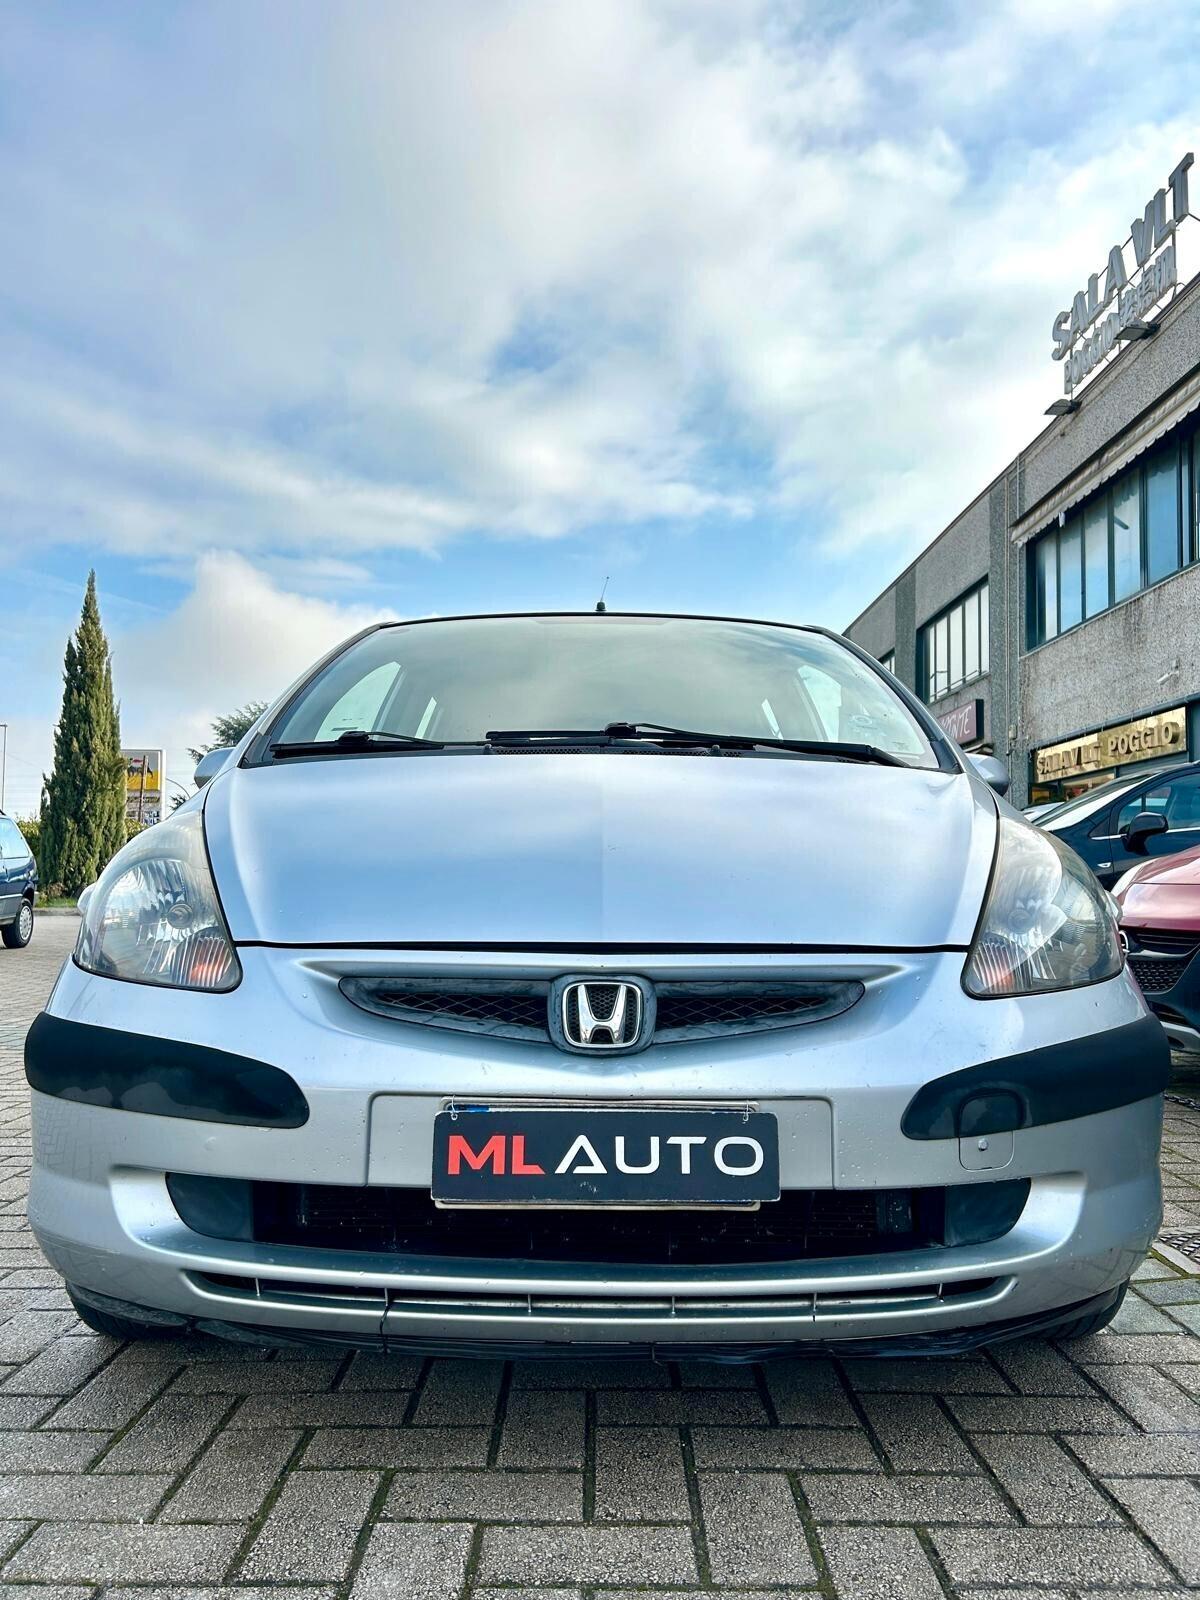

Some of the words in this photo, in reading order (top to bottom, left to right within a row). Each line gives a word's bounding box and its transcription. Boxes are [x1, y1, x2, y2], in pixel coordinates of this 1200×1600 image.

[1051, 245, 1128, 361] SALA
[1131, 152, 1194, 267] VLT
[1064, 312, 1120, 394] POGGIO
[1108, 721, 1180, 757] POGGIO
[447, 1134, 545, 1175] ML
[555, 1134, 764, 1176] AUTO
